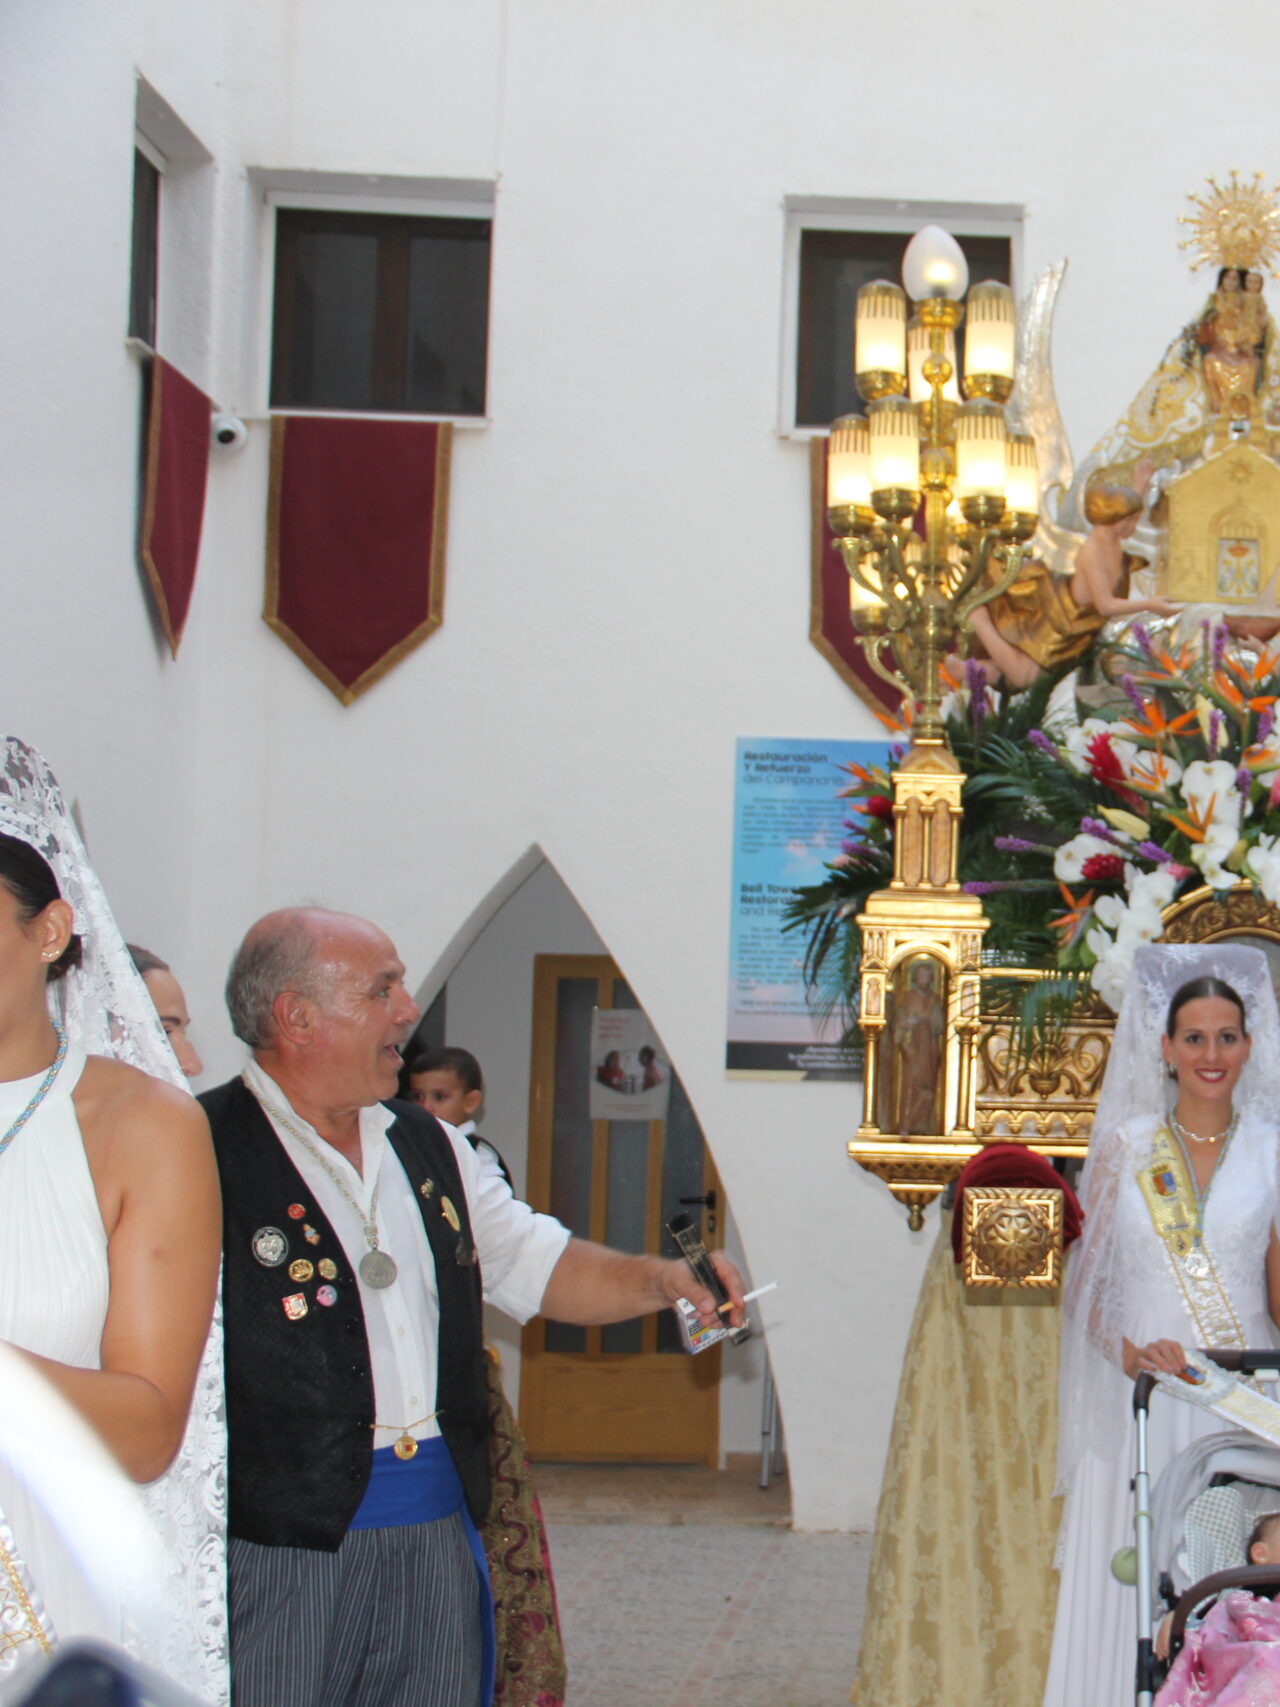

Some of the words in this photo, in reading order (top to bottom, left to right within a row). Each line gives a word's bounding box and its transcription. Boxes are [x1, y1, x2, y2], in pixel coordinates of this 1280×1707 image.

[744, 751, 828, 763] Restauración
[755, 763, 811, 774] Refuerzo
[741, 884, 763, 893] Bell
